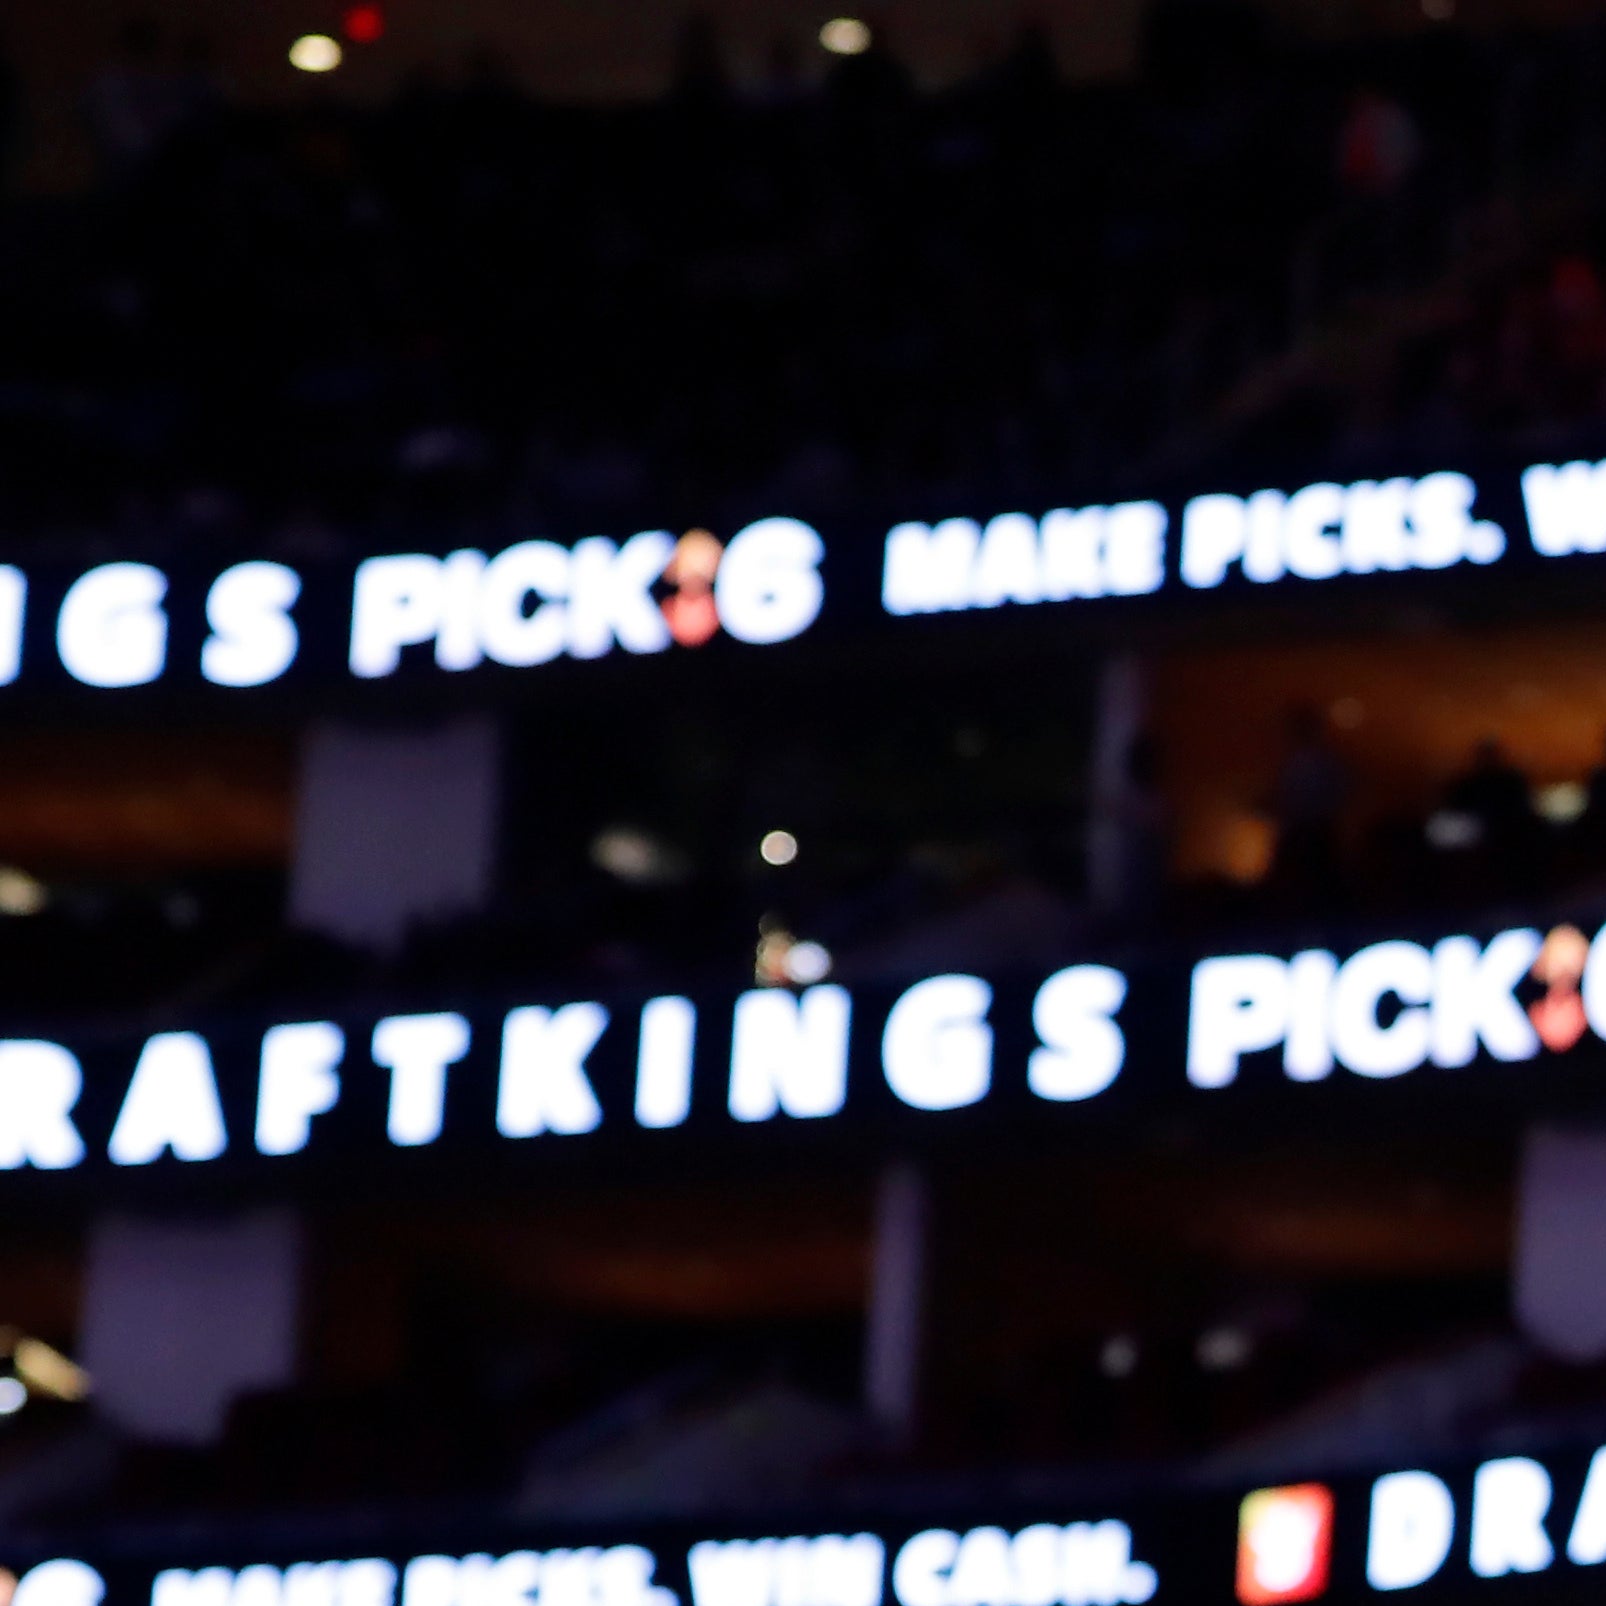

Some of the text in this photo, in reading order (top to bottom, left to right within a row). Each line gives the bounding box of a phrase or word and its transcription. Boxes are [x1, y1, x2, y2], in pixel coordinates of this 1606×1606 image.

[0, 563, 298, 687] GS
[882, 501, 1166, 615] MAKE
[1180, 472, 1505, 588] PICKS.
